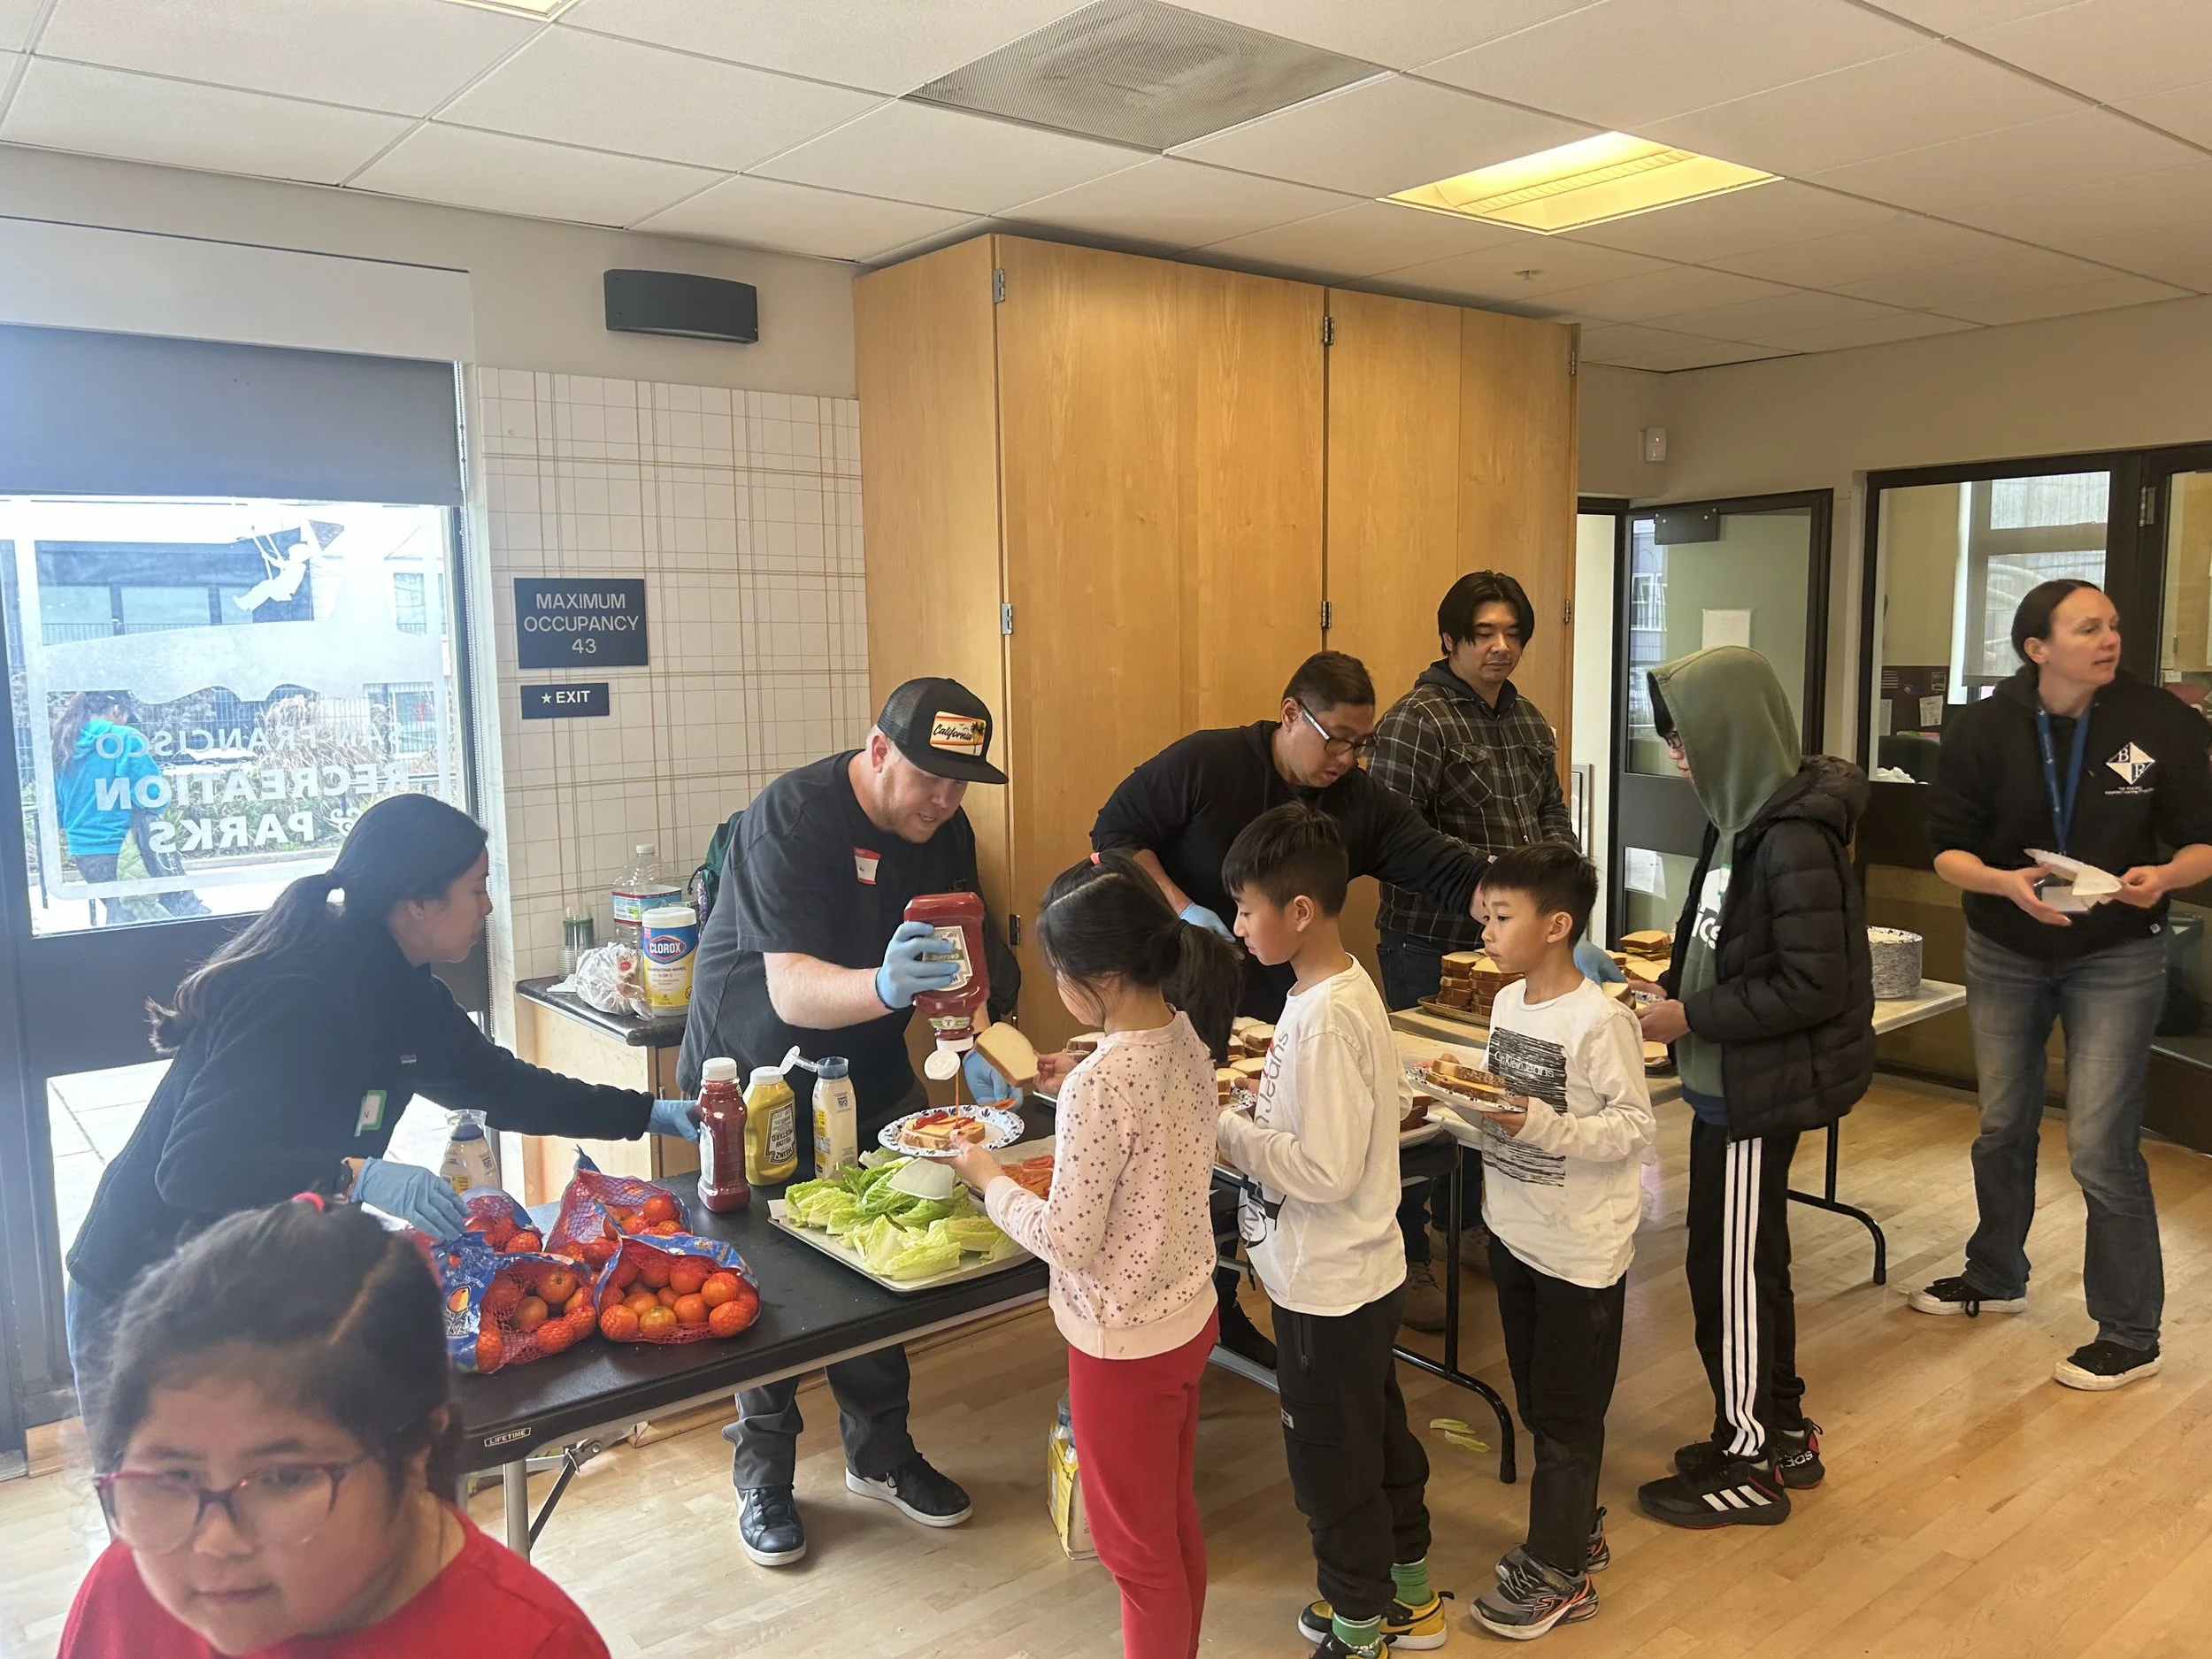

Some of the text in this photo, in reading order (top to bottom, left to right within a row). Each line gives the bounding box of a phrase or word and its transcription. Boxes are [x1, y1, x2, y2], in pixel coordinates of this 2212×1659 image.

[535, 593, 626, 610] MAXIMUM
[524, 615, 639, 632] OCCUPANCY
[572, 638, 596, 654] 43
[556, 690, 590, 703] EXIT
[933, 723, 973, 741] California
[649, 942, 681, 954] CLOROX
[1260, 1032, 1289, 1113] Jeans
[776, 1147, 792, 1158] HEINZ
[489, 1430, 526, 1444] LIFETIME
